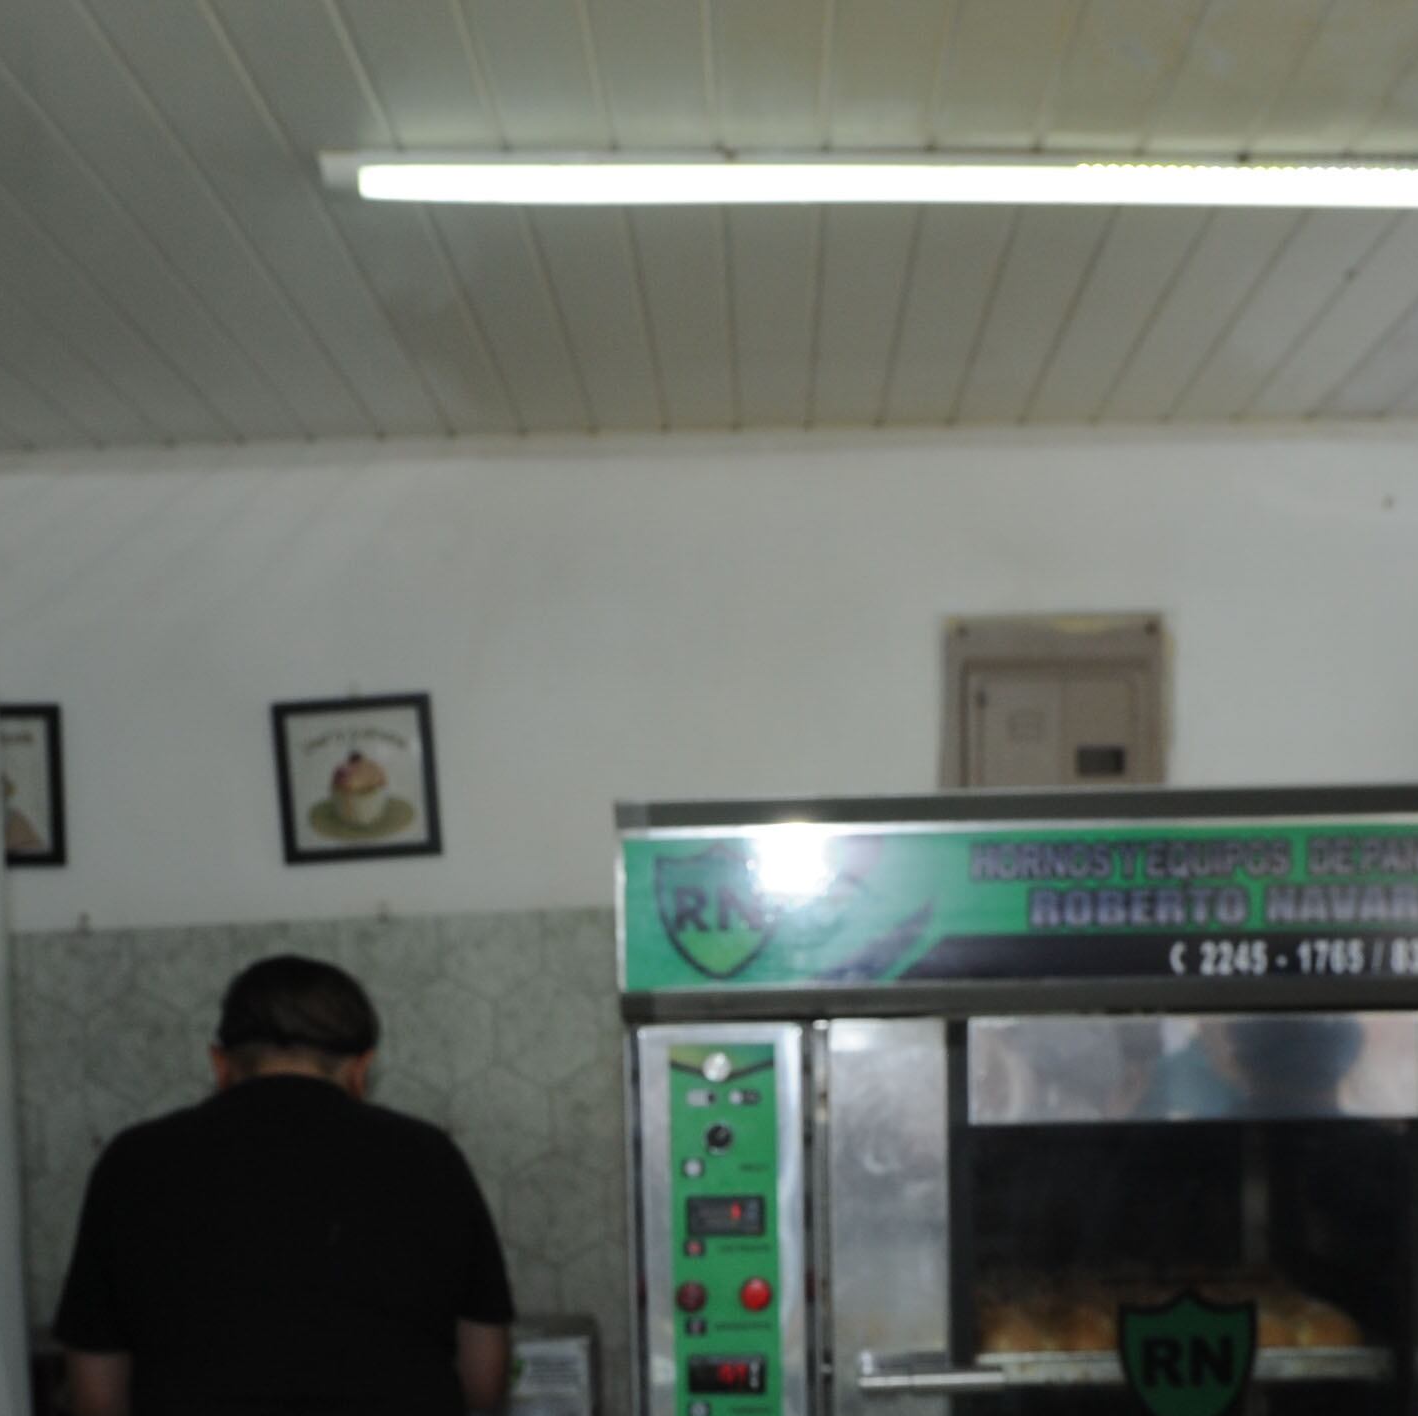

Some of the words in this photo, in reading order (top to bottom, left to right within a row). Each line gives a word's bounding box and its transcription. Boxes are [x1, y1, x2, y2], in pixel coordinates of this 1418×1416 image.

[969, 841, 1112, 883] HORNOS
[1116, 840, 1141, 881] Y
[1144, 837, 1292, 881] EQUIPOS
[1306, 836, 1355, 876] DE
[1030, 884, 1250, 929] ROBERTO
[1199, 940, 1268, 976] 2245
[1297, 938, 1365, 975] 1765
[1140, 1335, 1235, 1389] RN
